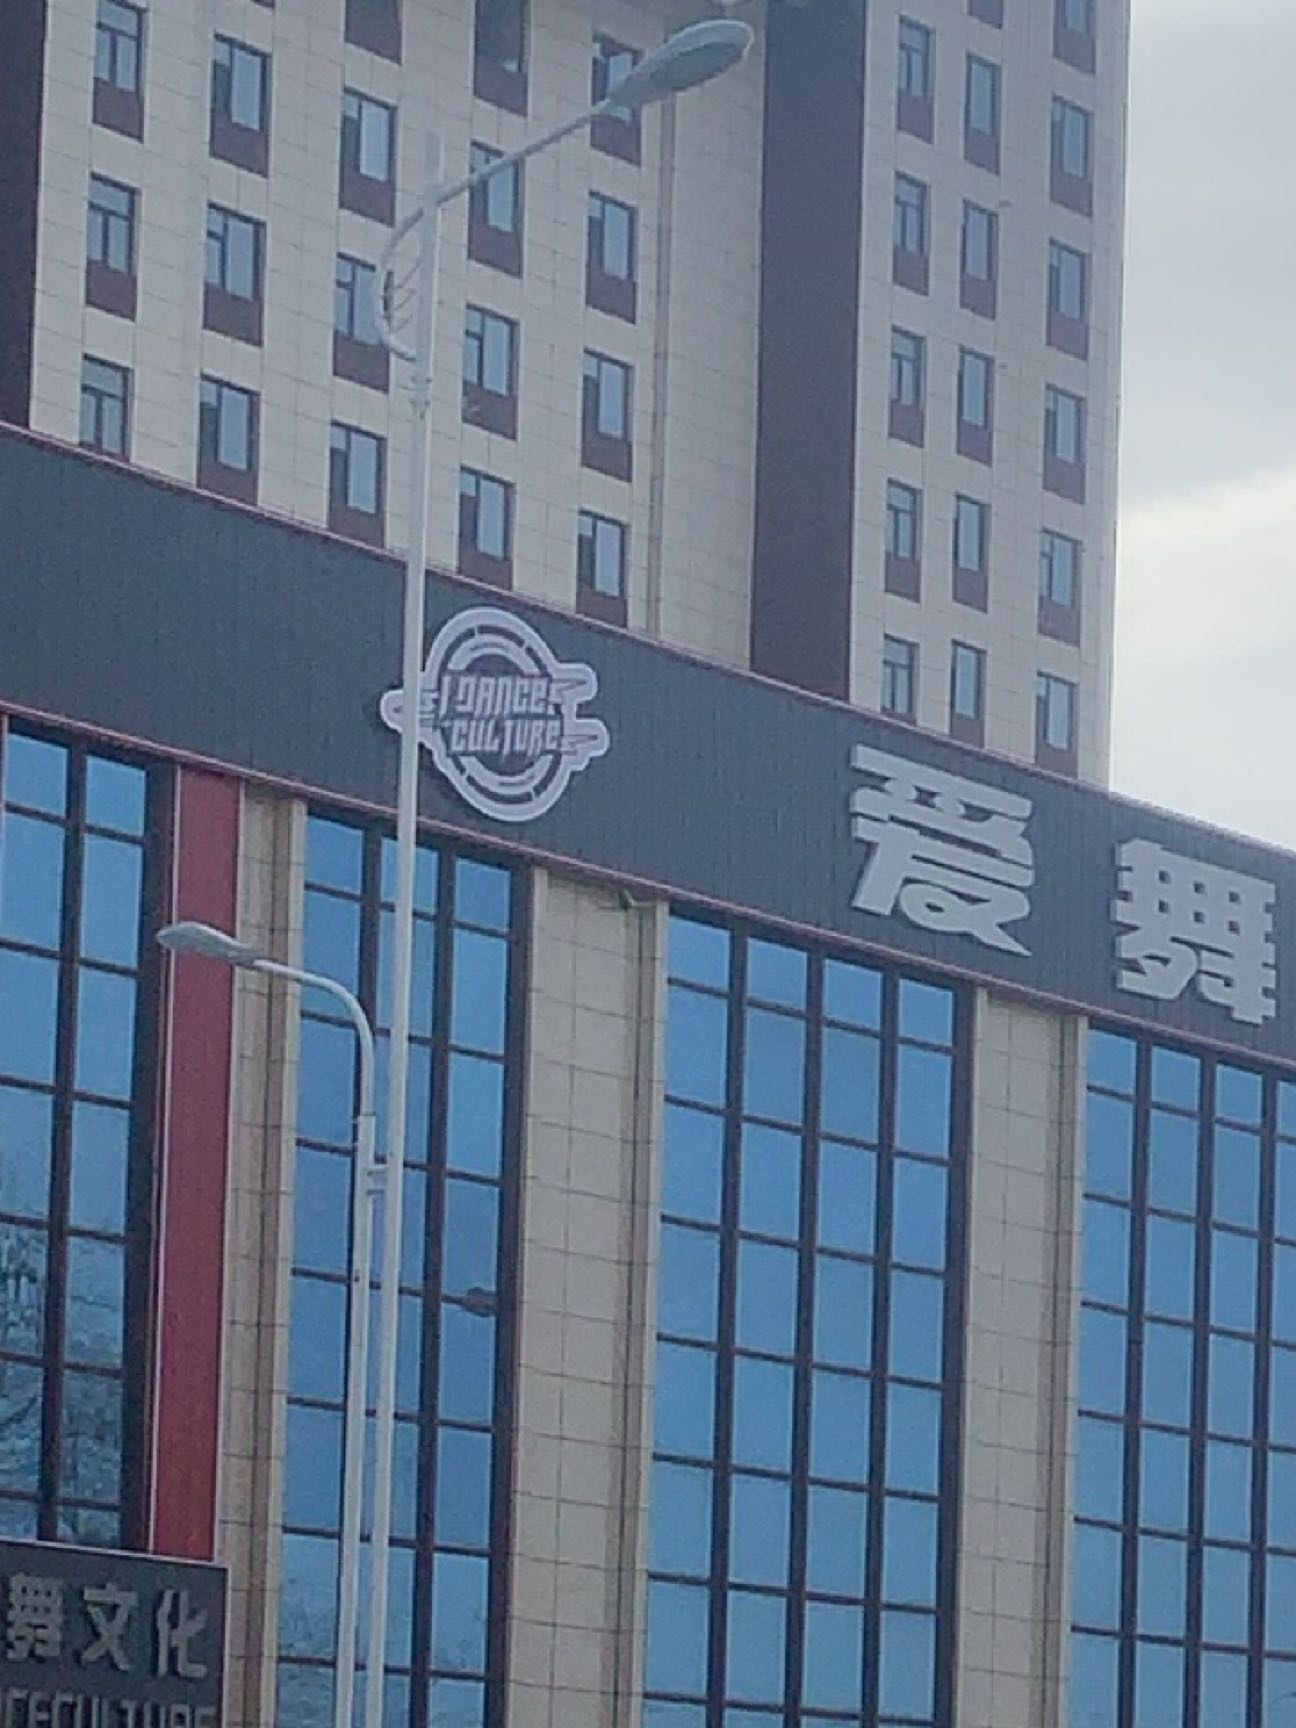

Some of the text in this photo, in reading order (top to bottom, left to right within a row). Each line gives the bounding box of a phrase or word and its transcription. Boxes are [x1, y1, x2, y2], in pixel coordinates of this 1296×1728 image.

[450, 718, 562, 757] CULTURE
[6, 1570, 208, 1680] 舞文化
